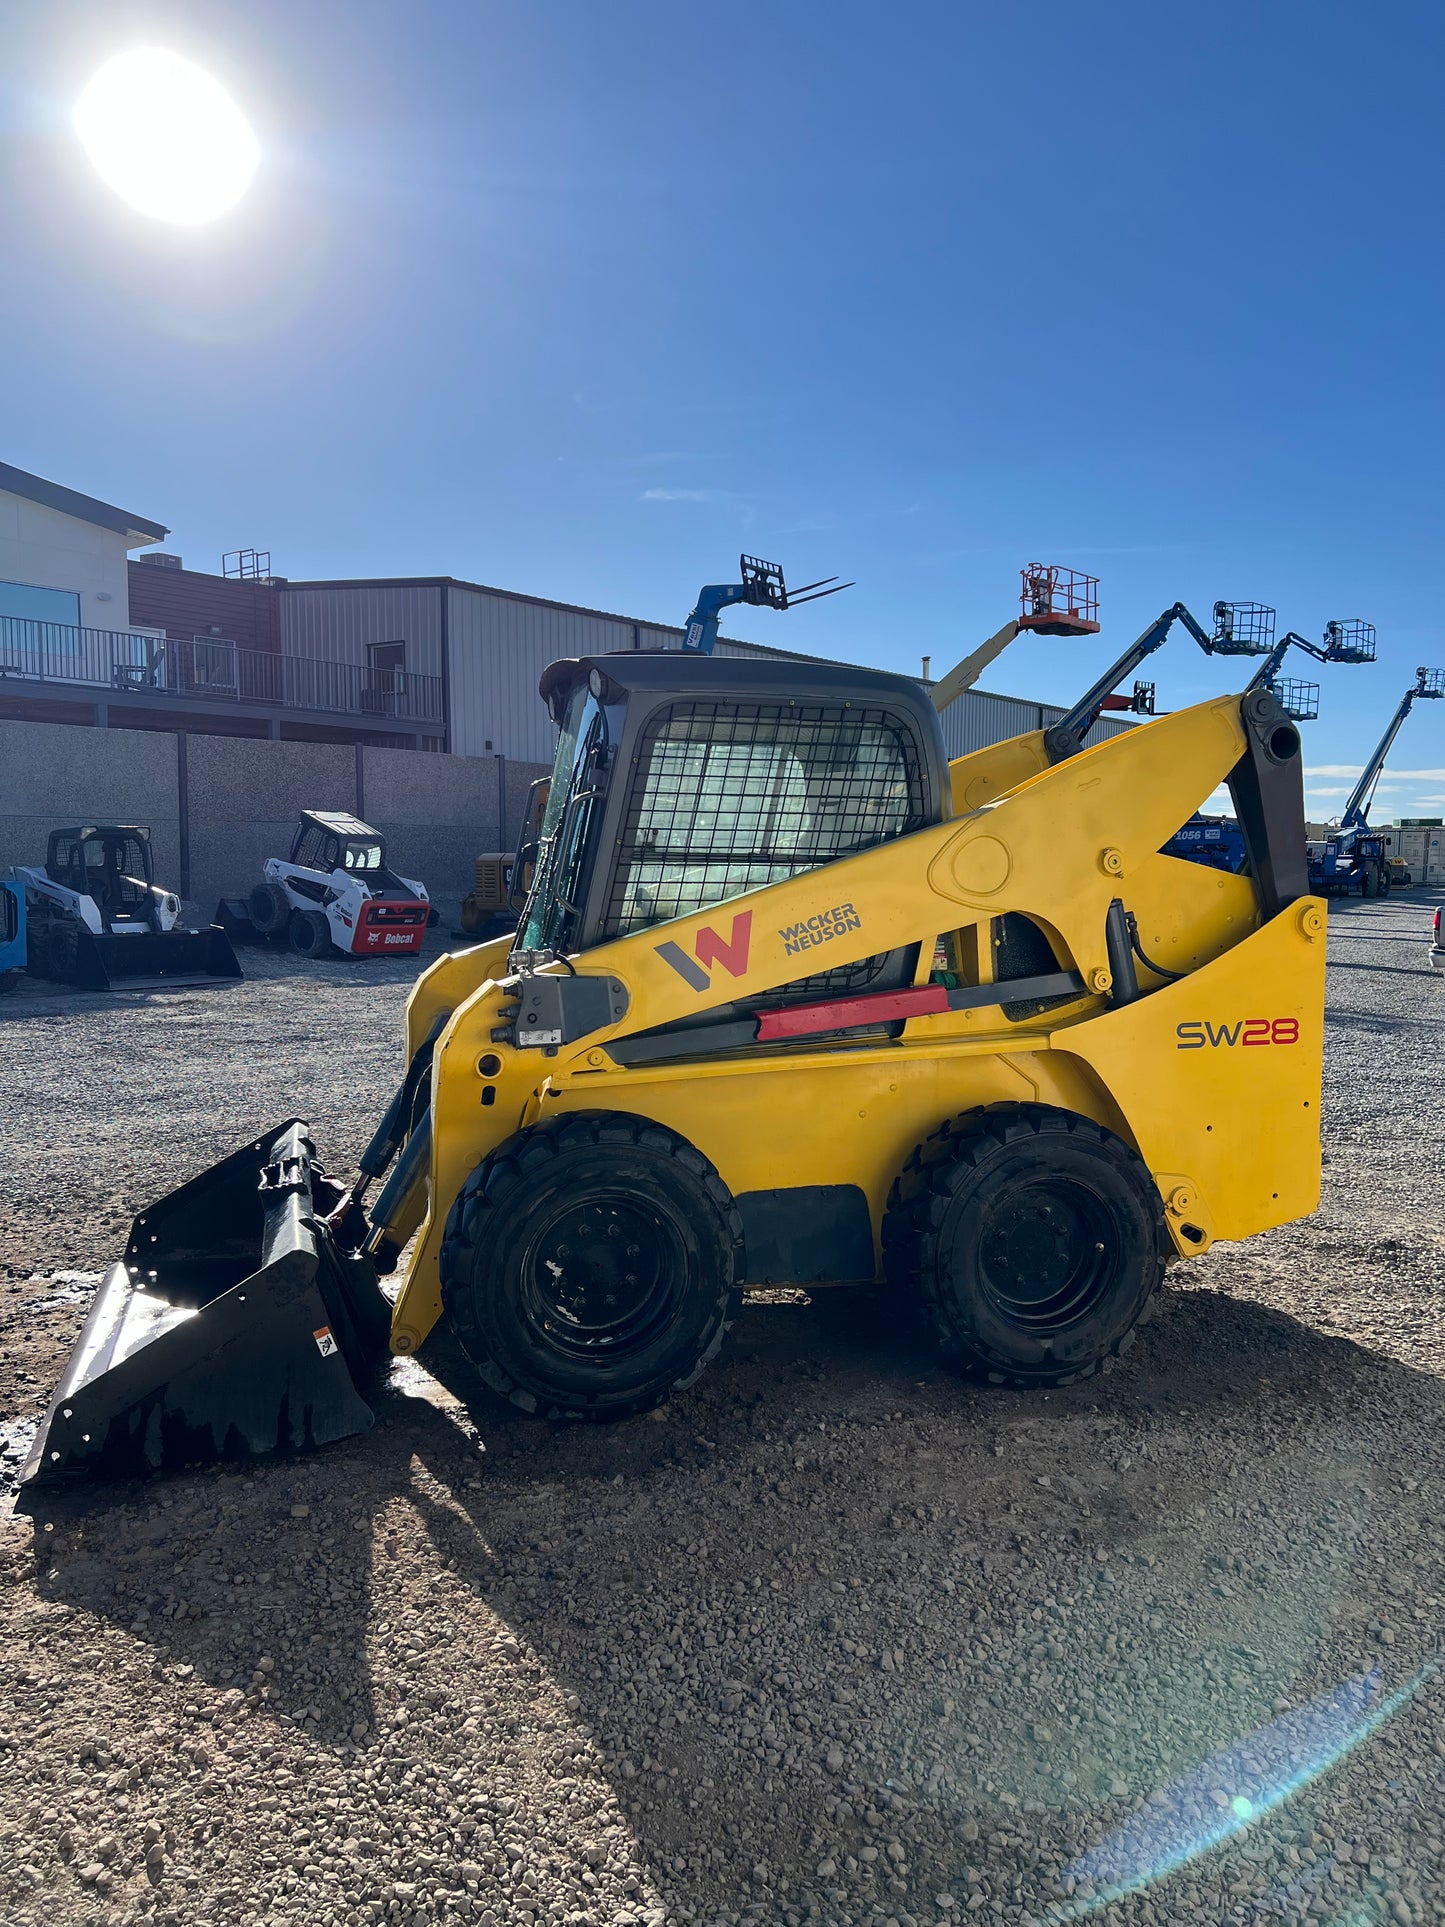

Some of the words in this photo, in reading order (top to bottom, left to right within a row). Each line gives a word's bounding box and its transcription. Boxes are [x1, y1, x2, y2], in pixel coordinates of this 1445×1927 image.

[384, 933, 414, 944] Bobcat
[777, 903, 857, 942] WACKER
[784, 915, 862, 957] NEUSON
[1176, 1018, 1299, 1049] SW28
